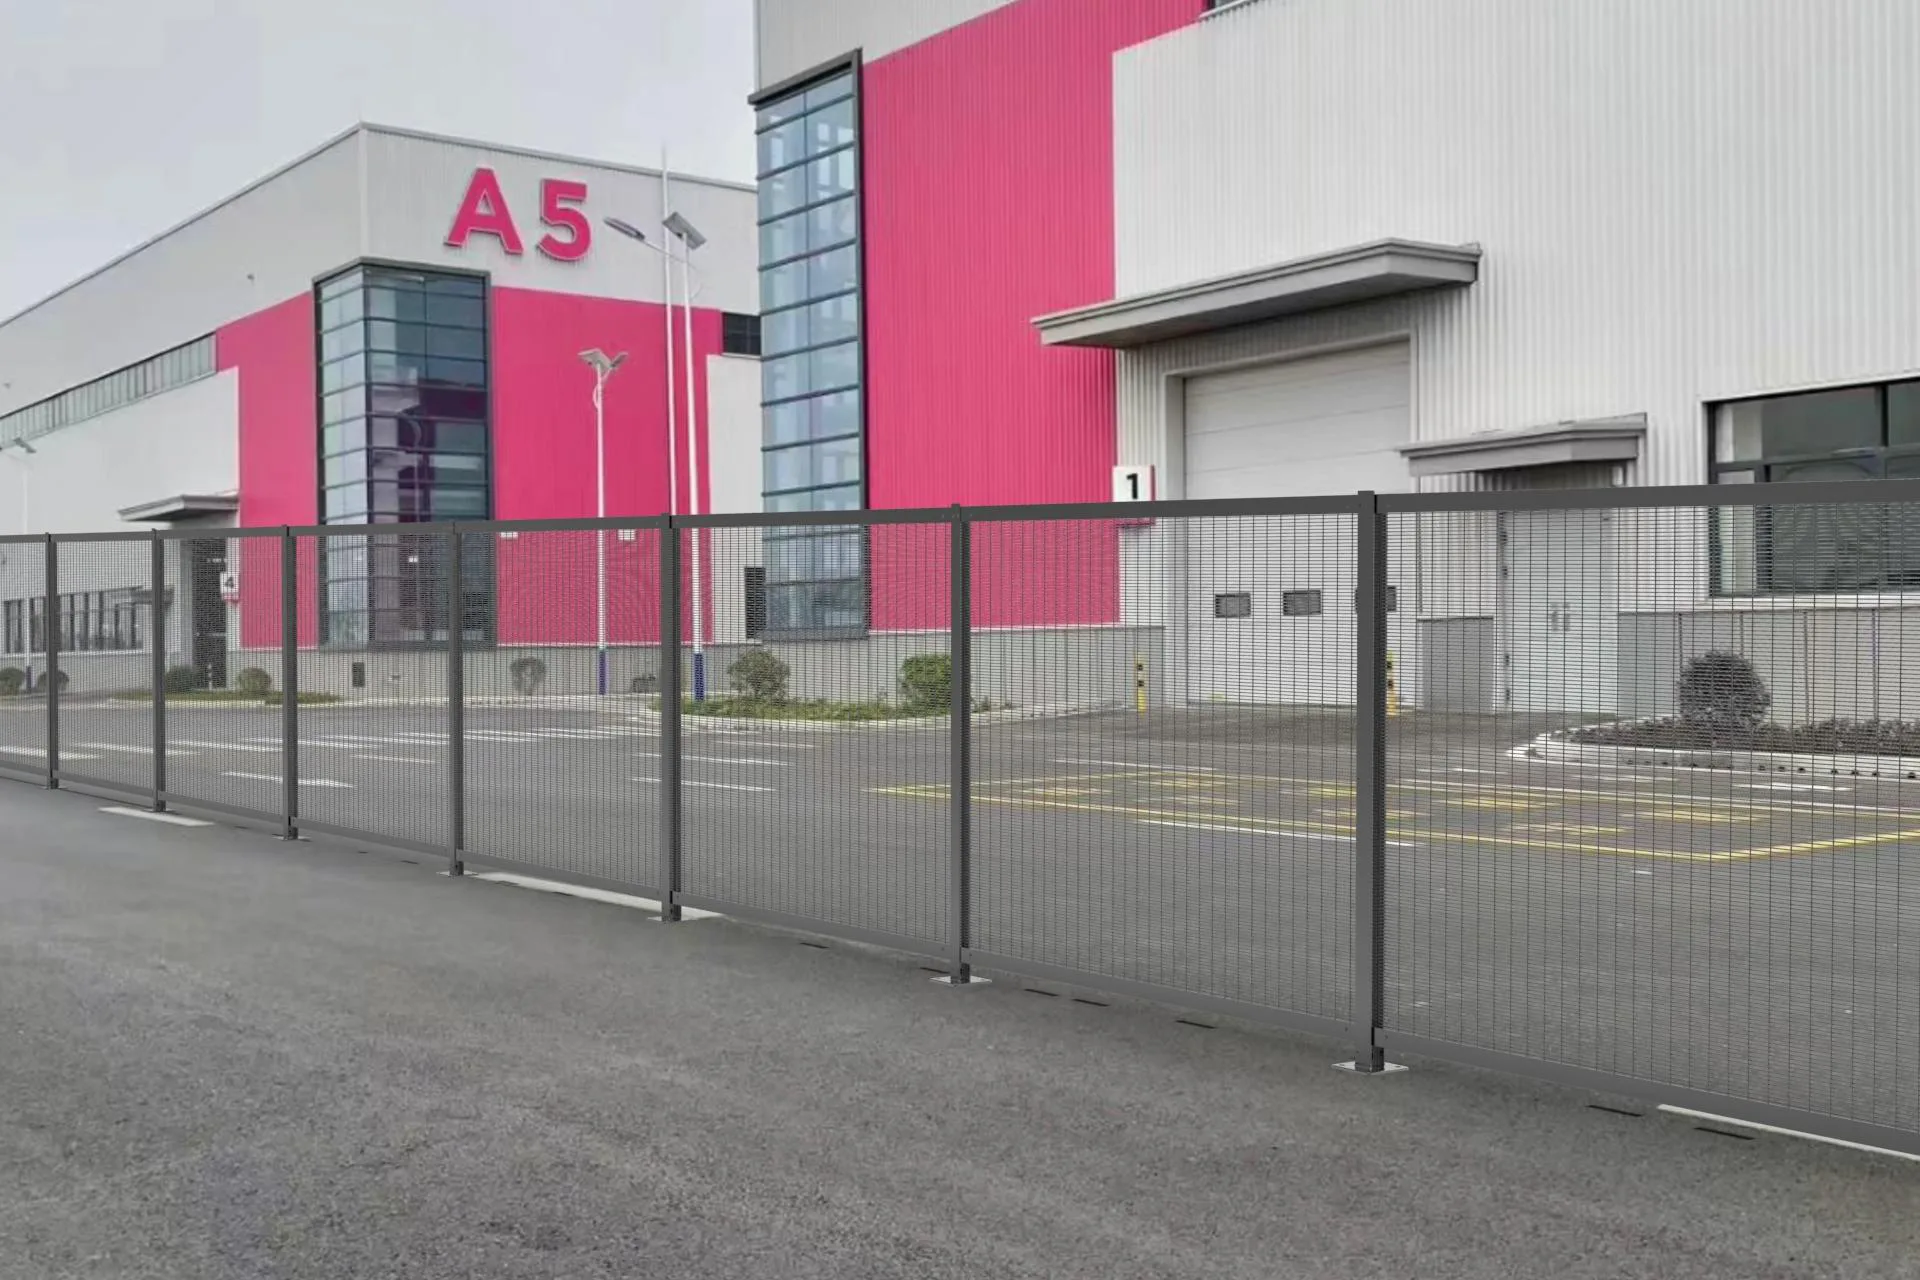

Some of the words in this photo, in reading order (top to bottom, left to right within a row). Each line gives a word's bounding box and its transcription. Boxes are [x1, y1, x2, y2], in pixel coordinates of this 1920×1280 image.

[444, 167, 592, 261] A5
[1126, 472, 1138, 500] 1
[224, 576, 235, 589] 4
